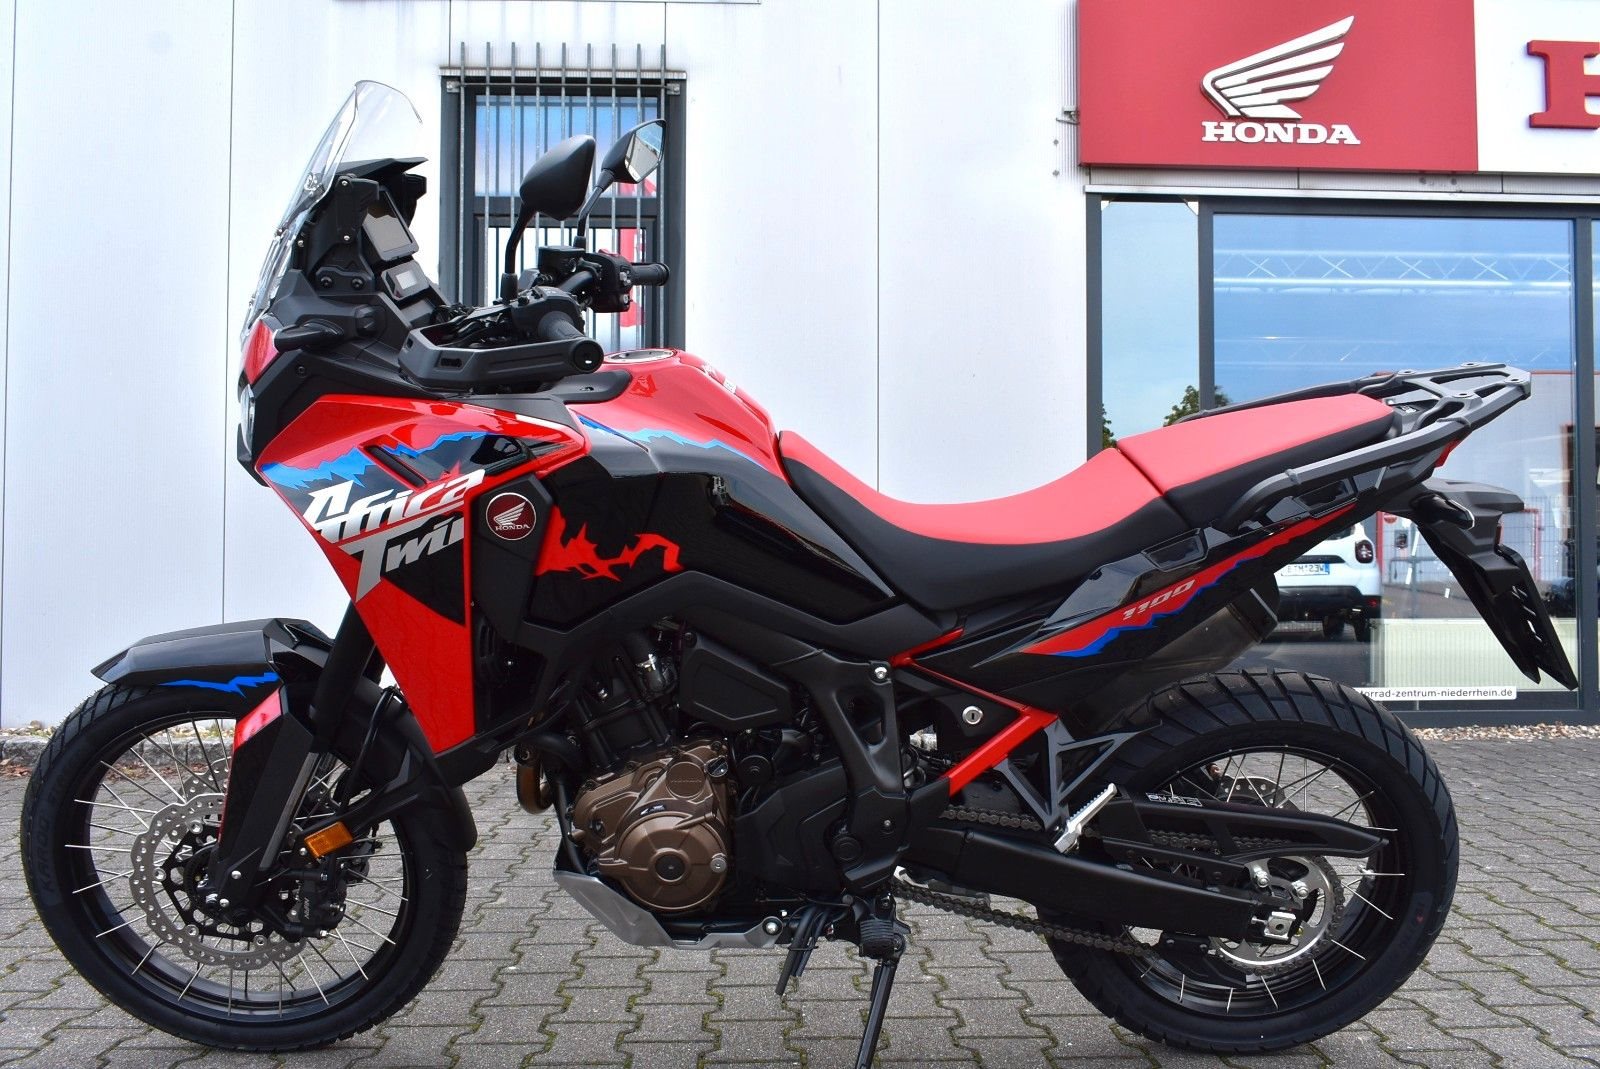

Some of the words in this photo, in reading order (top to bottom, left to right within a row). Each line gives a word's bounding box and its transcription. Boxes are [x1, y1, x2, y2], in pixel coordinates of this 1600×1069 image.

[1201, 121, 1361, 145] HONDA
[302, 468, 486, 544] Africa
[1122, 579, 1196, 621] 1100
